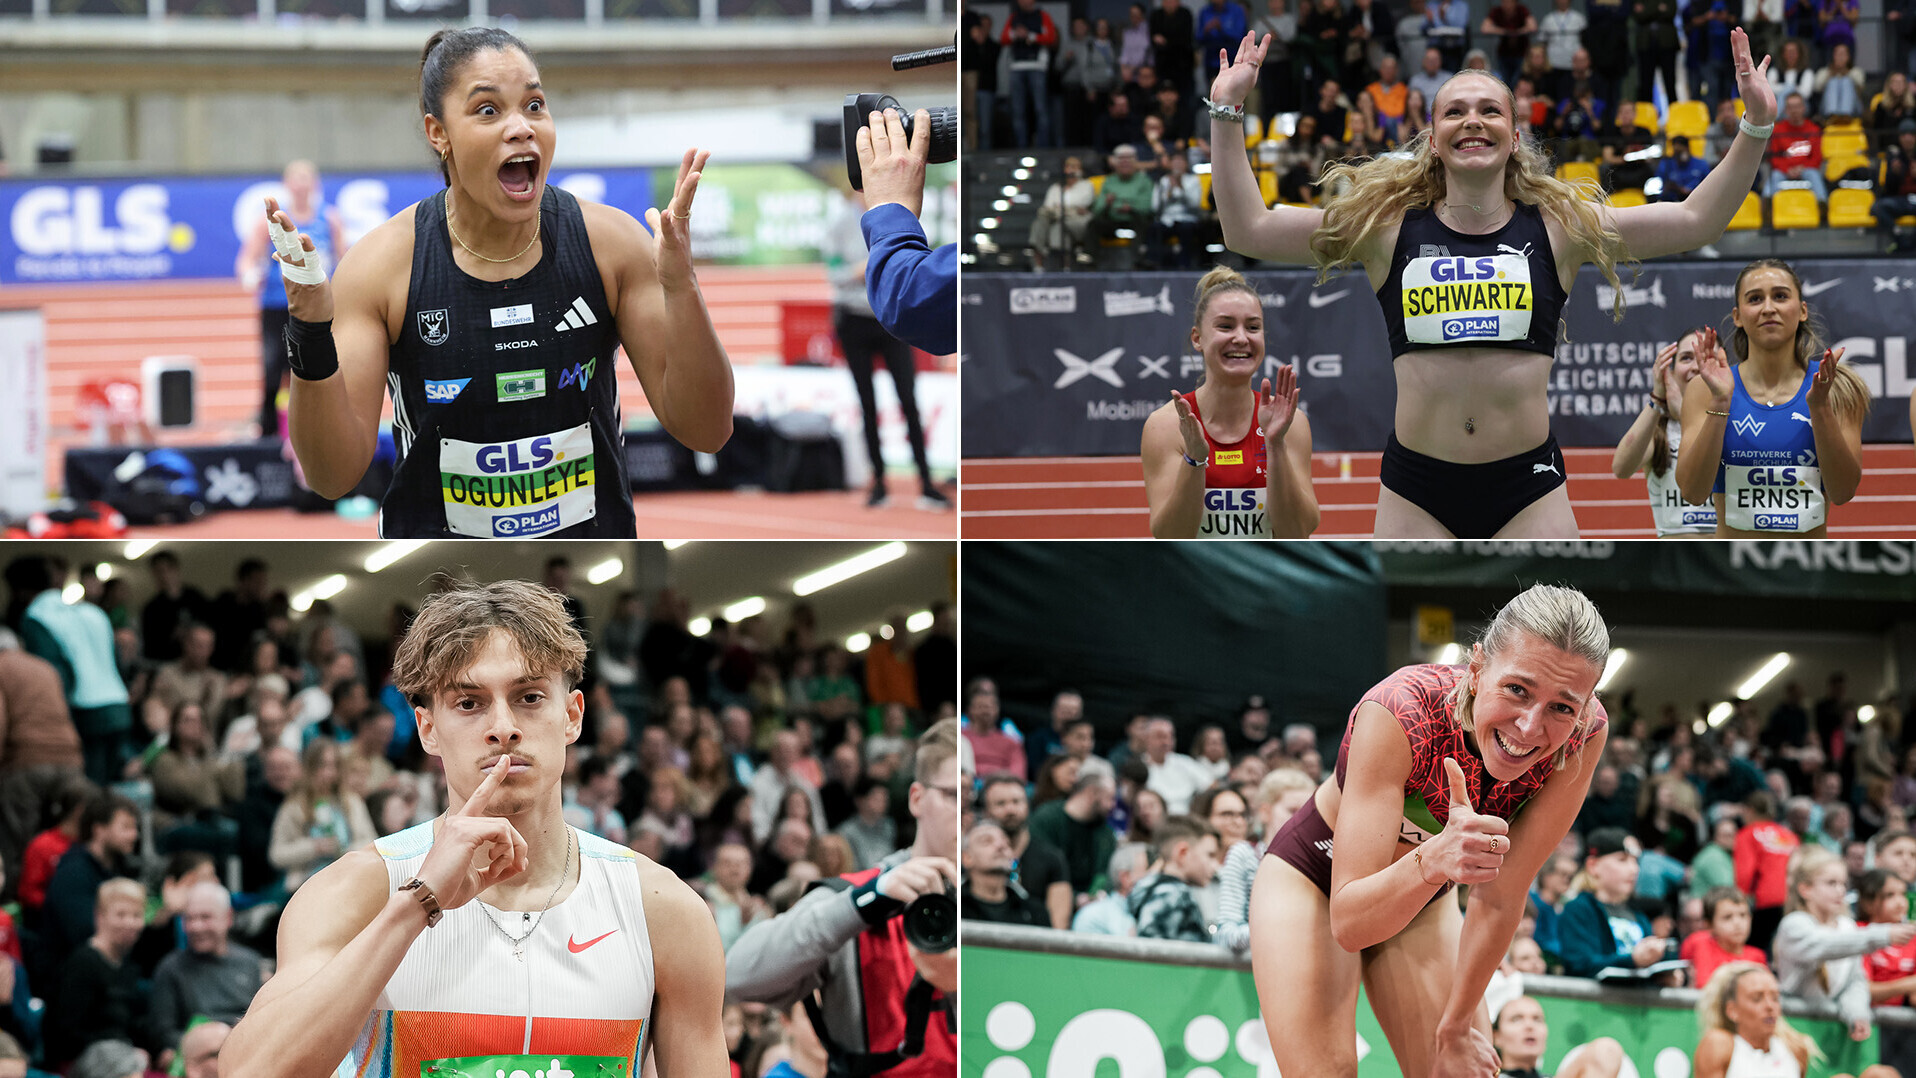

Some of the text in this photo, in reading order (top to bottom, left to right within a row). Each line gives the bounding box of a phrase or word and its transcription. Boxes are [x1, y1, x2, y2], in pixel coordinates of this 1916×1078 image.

[1408, 283, 1527, 316] SCHWARTZ
[421, 312, 444, 323] MTG
[494, 317, 531, 326] BUNDESWEHR
[1465, 320, 1497, 330] PLAN
[425, 383, 461, 400] SAP
[1731, 450, 1792, 459] STADTWERKE
[450, 458, 588, 508] OGUNLEYE
[1738, 488, 1814, 509] ERNST
[521, 510, 558, 527] PLAN
[1201, 513, 1264, 535] JUNK
[1772, 516, 1797, 525] PLAN
[1730, 541, 1916, 575] KARLS
